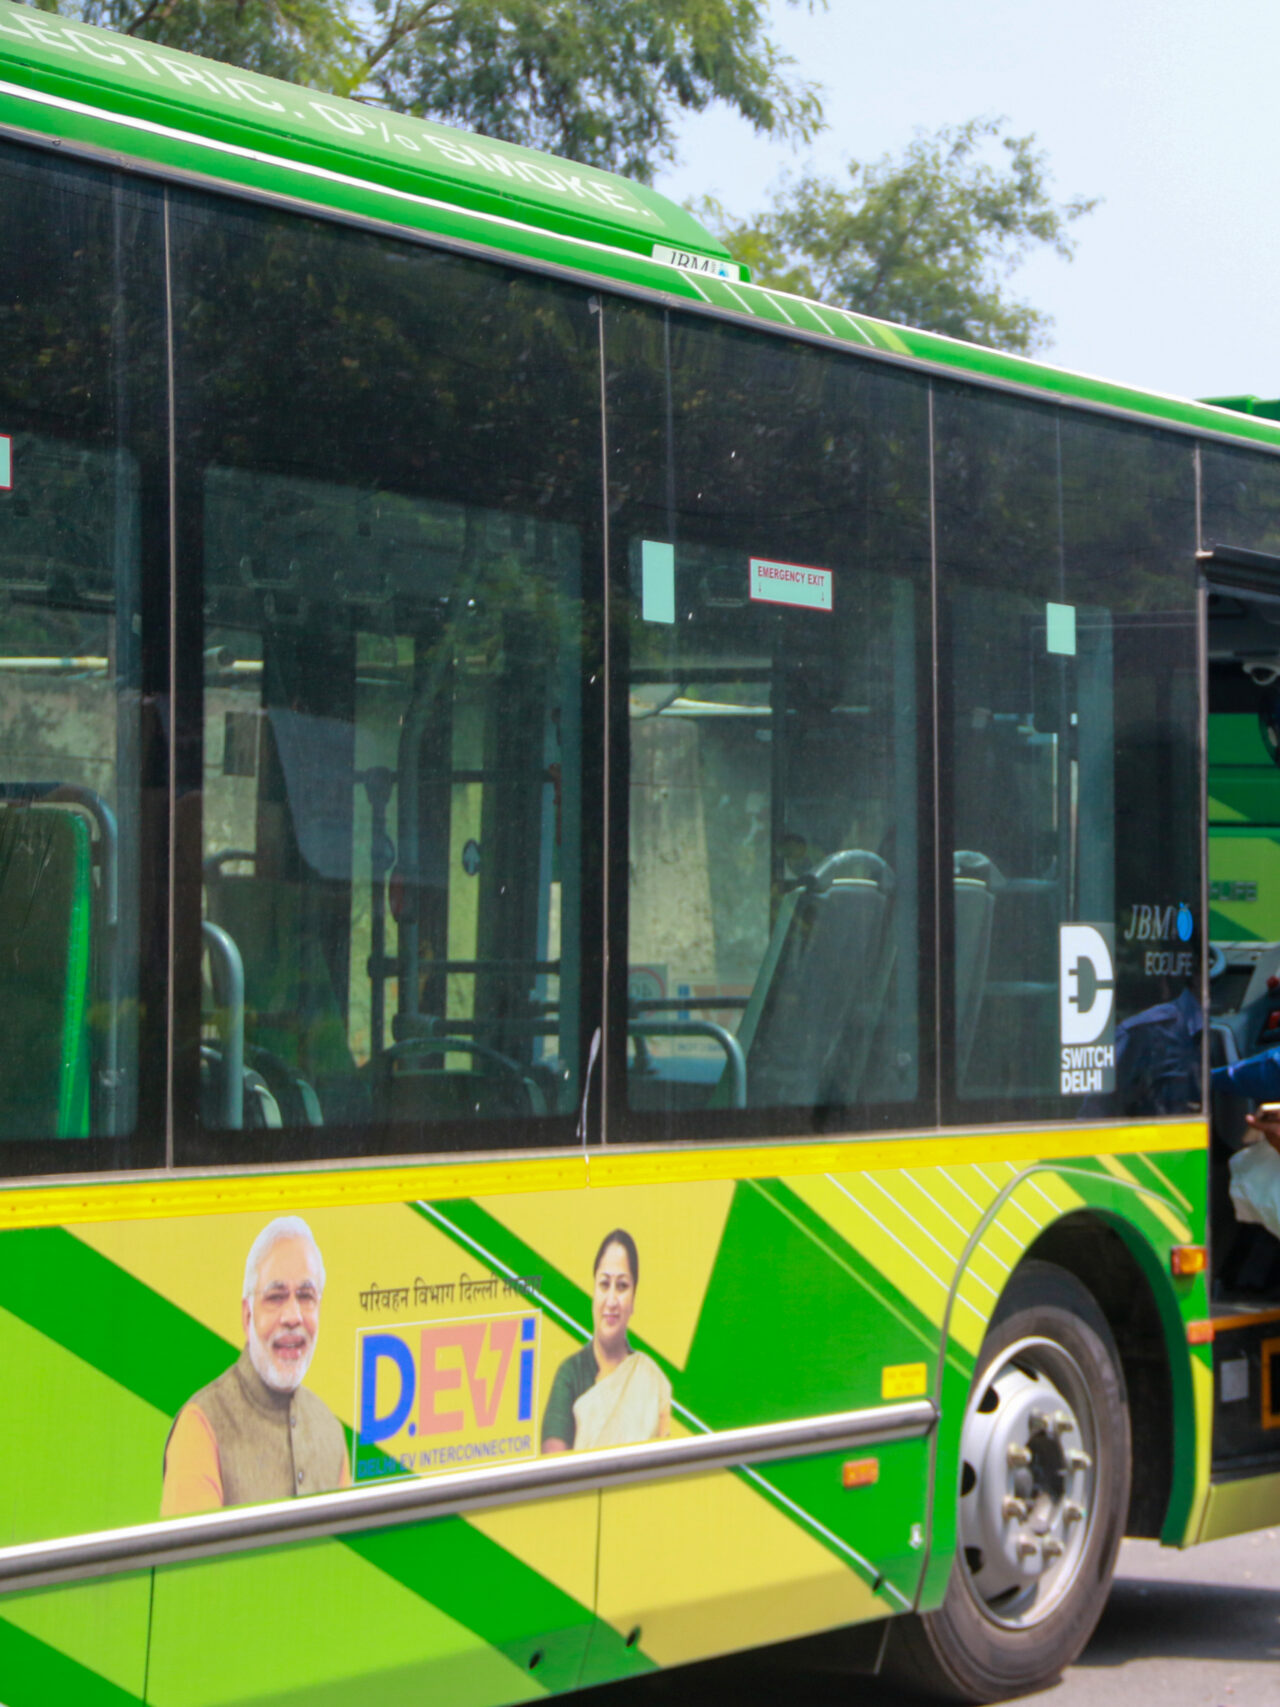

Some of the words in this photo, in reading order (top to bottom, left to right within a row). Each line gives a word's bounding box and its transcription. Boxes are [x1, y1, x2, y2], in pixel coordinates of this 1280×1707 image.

[757, 565, 806, 584] EMERGENCY
[807, 575, 825, 587] EXIT
[1124, 904, 1174, 940] JBM
[1061, 1045, 1114, 1069] SWITCH
[1061, 1069, 1103, 1095] DELHI
[360, 1282, 410, 1312] परिवहन
[413, 1276, 455, 1307] विभाग
[459, 1272, 498, 1304] दिल्ली
[357, 1457, 397, 1478] DELHI
[401, 1453, 417, 1472] EV
[419, 1435, 531, 1468] INTERCONNECTOR
